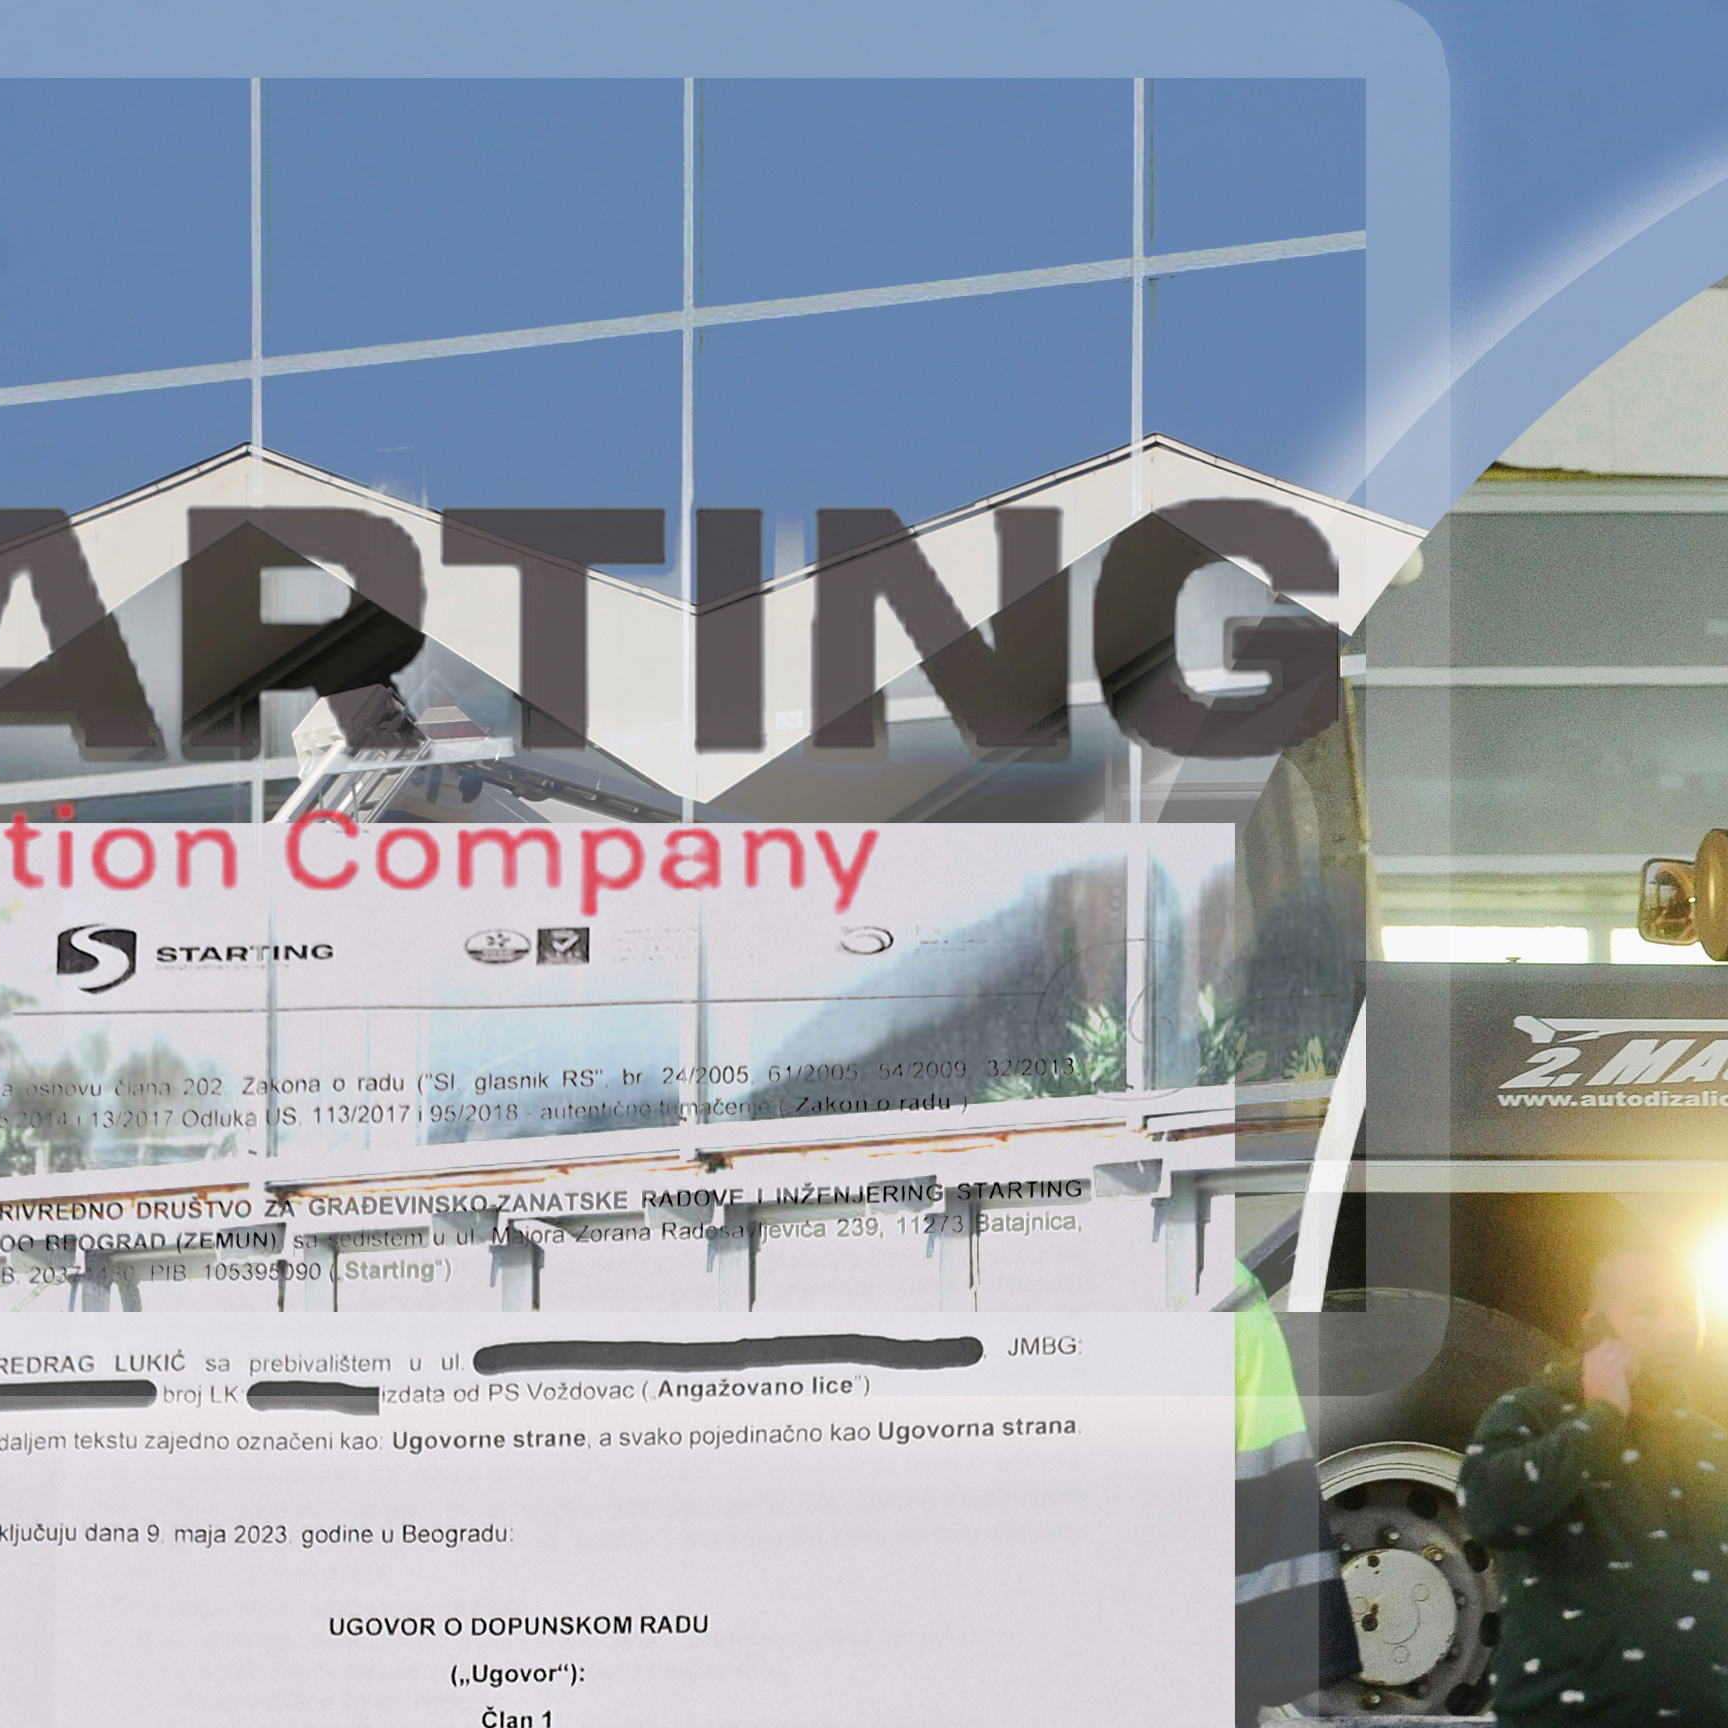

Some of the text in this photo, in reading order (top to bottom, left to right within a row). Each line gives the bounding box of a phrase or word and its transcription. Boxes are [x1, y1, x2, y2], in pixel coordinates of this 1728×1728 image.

[156, 944, 335, 964] STARTING
[1007, 1335, 1082, 1357] JMBG:
[114, 1350, 187, 1374] LUKIĆ
[204, 1358, 232, 1374] sa
[249, 1353, 393, 1378] prebivalištem
[409, 1357, 422, 1372] u
[440, 1352, 466, 1374] ul.
[162, 1383, 203, 1410] broj
[381, 1383, 446, 1405] izdata
[453, 1384, 481, 1405] od
[488, 1383, 520, 1404] PS
[526, 1379, 635, 1403] Voždovac
[73, 1430, 138, 1450] tekstu
[144, 1431, 230, 1455] zajedno
[235, 1431, 334, 1452] označeni
[340, 1430, 384, 1451] kao:
[392, 1430, 506, 1456] Ugovorne
[512, 1429, 592, 1450] strane,
[598, 1431, 612, 1448] a
[618, 1426, 683, 1447] svako
[689, 1423, 823, 1450] pojedinačno
[830, 1422, 872, 1442] kao
[878, 1420, 995, 1446] Ugovorna
[1001, 1417, 1082, 1437] strana.
[84, 1522, 140, 1544] dana
[146, 1523, 165, 1544] 9.
[174, 1524, 227, 1549] maja
[233, 1524, 293, 1545] 2023.
[301, 1524, 374, 1550] godine
[381, 1528, 395, 1545] u
[401, 1523, 514, 1549] Beogradu:
[328, 1614, 709, 1637] UGOVOR O DOPUNSKOM RADU
[450, 1662, 585, 1689] („Ugovor“):
[541, 1709, 552, 1728] 1
